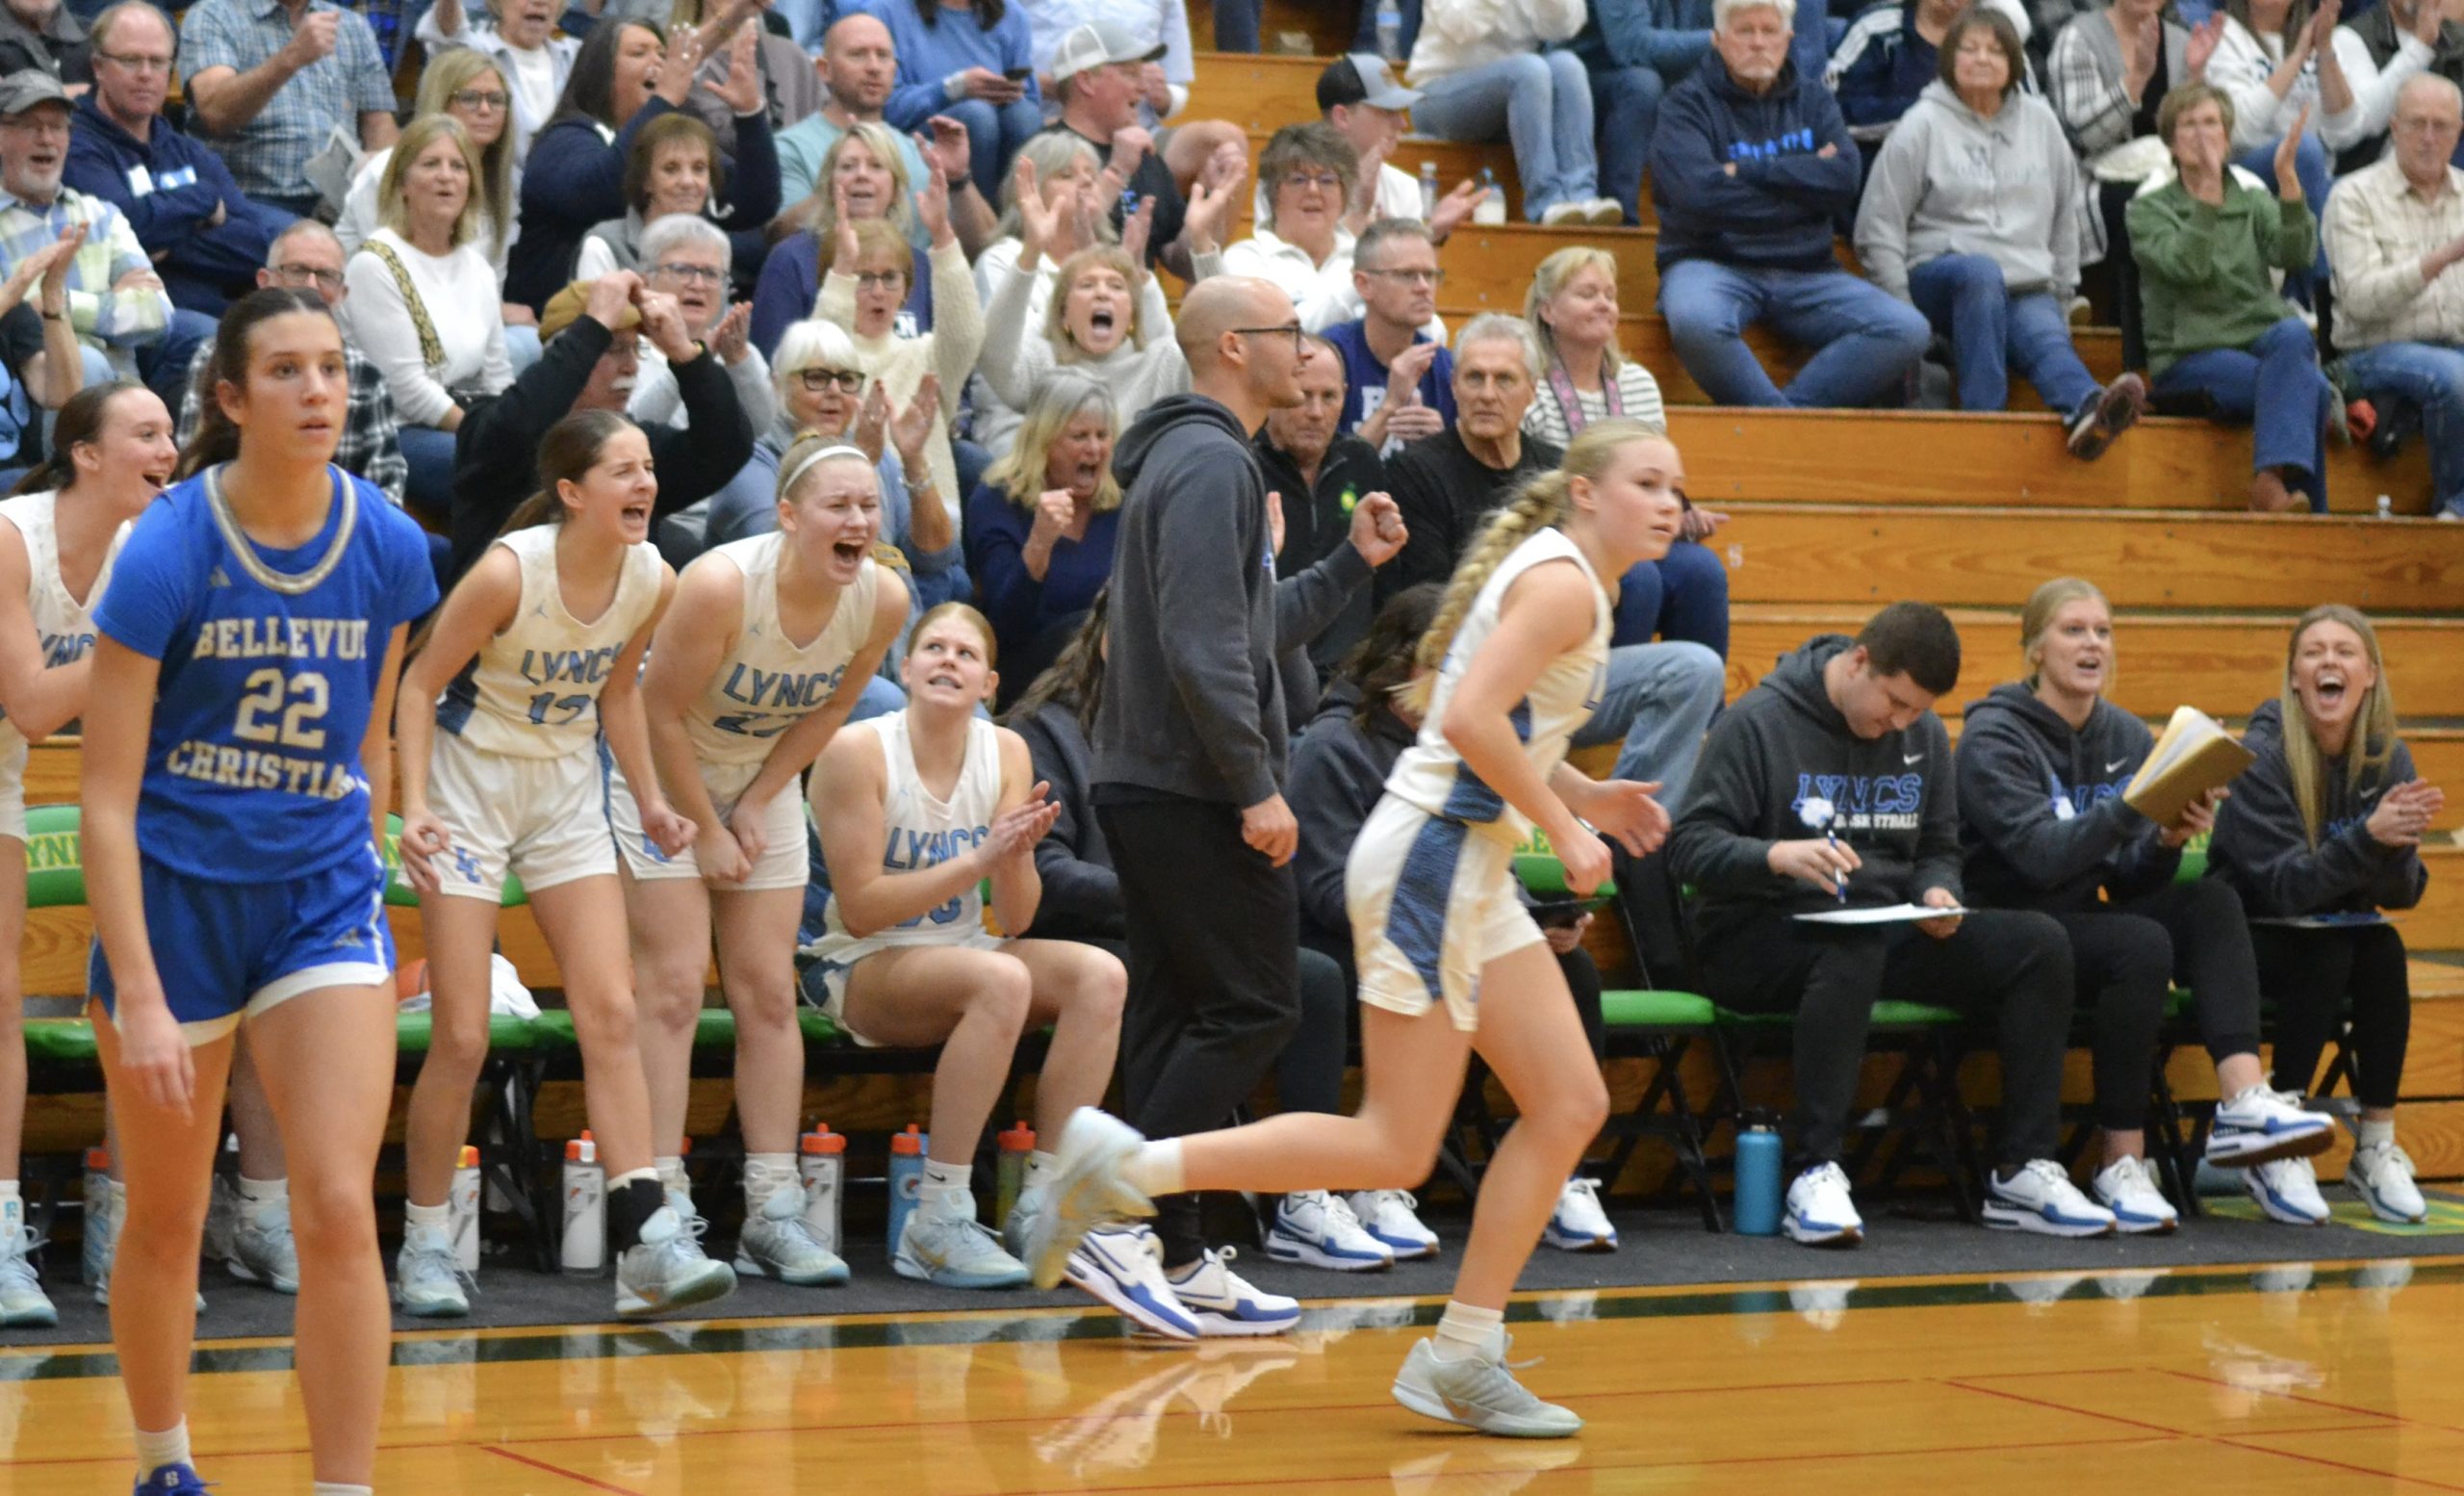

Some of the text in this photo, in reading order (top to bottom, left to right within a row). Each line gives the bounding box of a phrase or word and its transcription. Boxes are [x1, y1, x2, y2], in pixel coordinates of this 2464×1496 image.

[233, 667, 329, 750] 22
[167, 740, 355, 801] CHRISTIA
[1790, 772, 1923, 813] LYNCS
